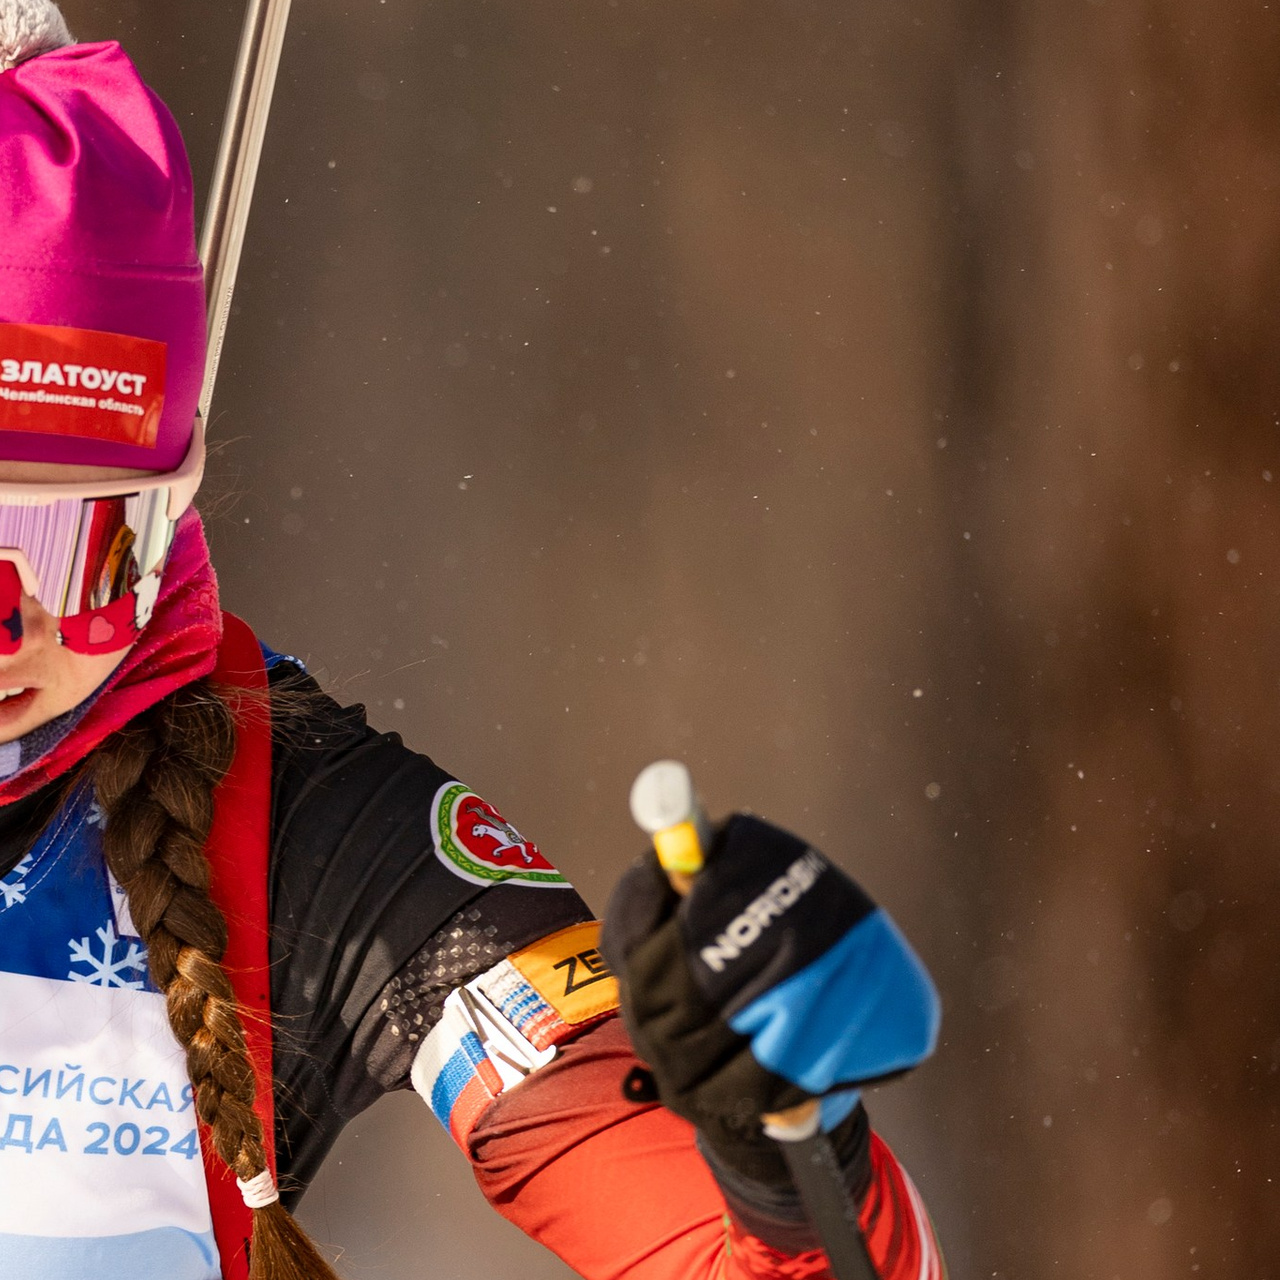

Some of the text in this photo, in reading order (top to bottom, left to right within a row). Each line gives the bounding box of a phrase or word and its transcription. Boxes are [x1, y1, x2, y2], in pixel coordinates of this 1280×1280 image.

[0, 358, 147, 397] ЗЛАТОУСТ
[97, 397, 145, 417] область
[699, 848, 827, 972] NORDS
[553, 947, 611, 997] ZE
[84, 1121, 199, 1160] 2024
